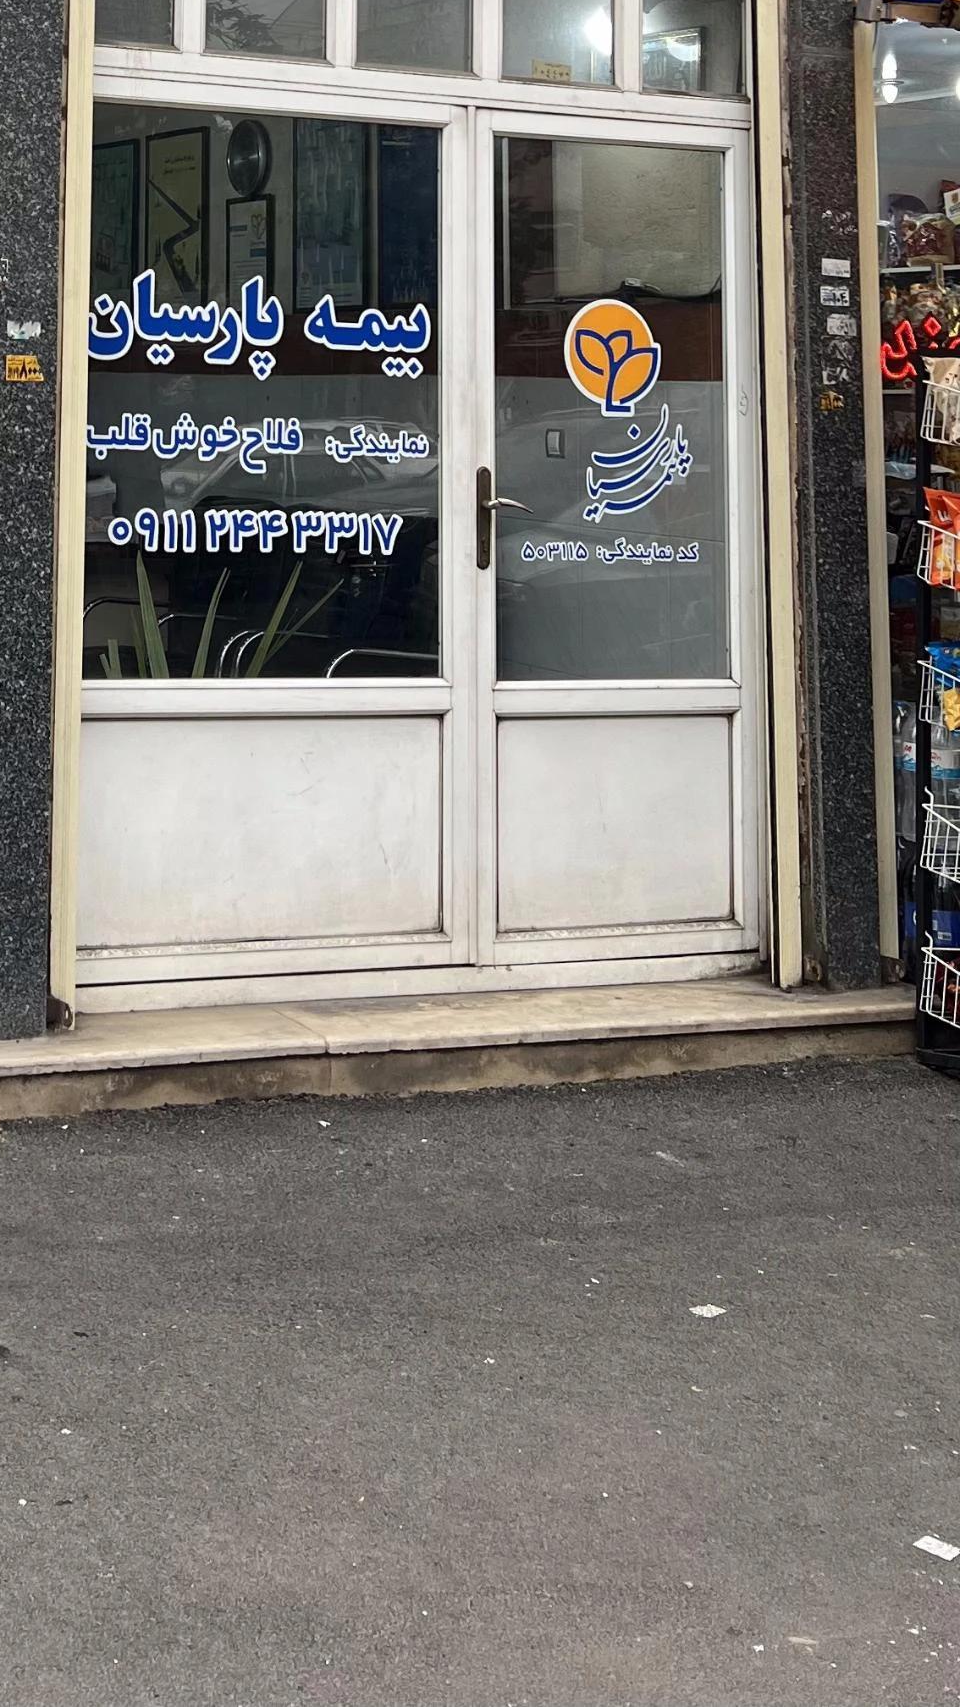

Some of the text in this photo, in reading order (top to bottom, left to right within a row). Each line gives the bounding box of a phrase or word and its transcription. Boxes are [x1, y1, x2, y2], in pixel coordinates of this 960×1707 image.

[88, 269, 432, 381] بیمه پارسیان
[87, 413, 152, 460] قلب
[153, 413, 239, 462] خوش
[240, 417, 304, 474] فلاح
[108, 508, 403, 556] ۰۹۱۱ ۲۴۴ ۳۳۱۷
[521, 541, 588, 562] ۵۰۳۱۱۵
[677, 542, 699, 562] کد
